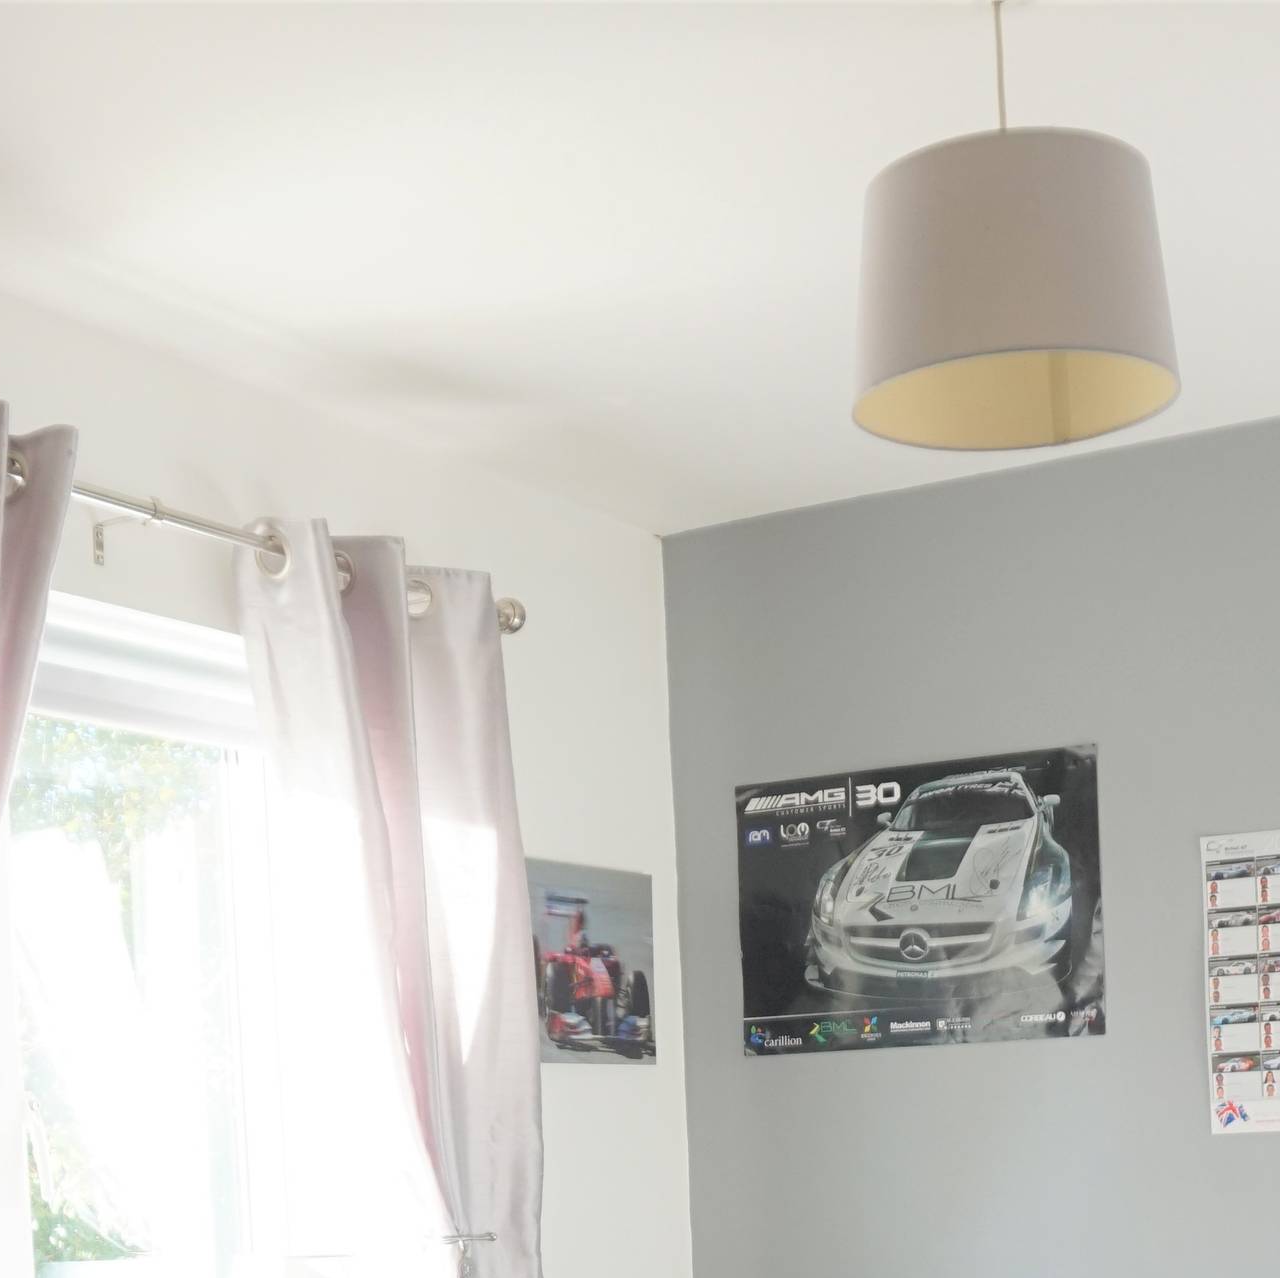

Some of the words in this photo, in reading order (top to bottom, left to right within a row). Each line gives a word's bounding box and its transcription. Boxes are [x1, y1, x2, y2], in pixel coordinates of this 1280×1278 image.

[776, 787, 846, 808] AMG
[855, 781, 901, 806] 30
[764, 1035, 802, 1047] carillion
